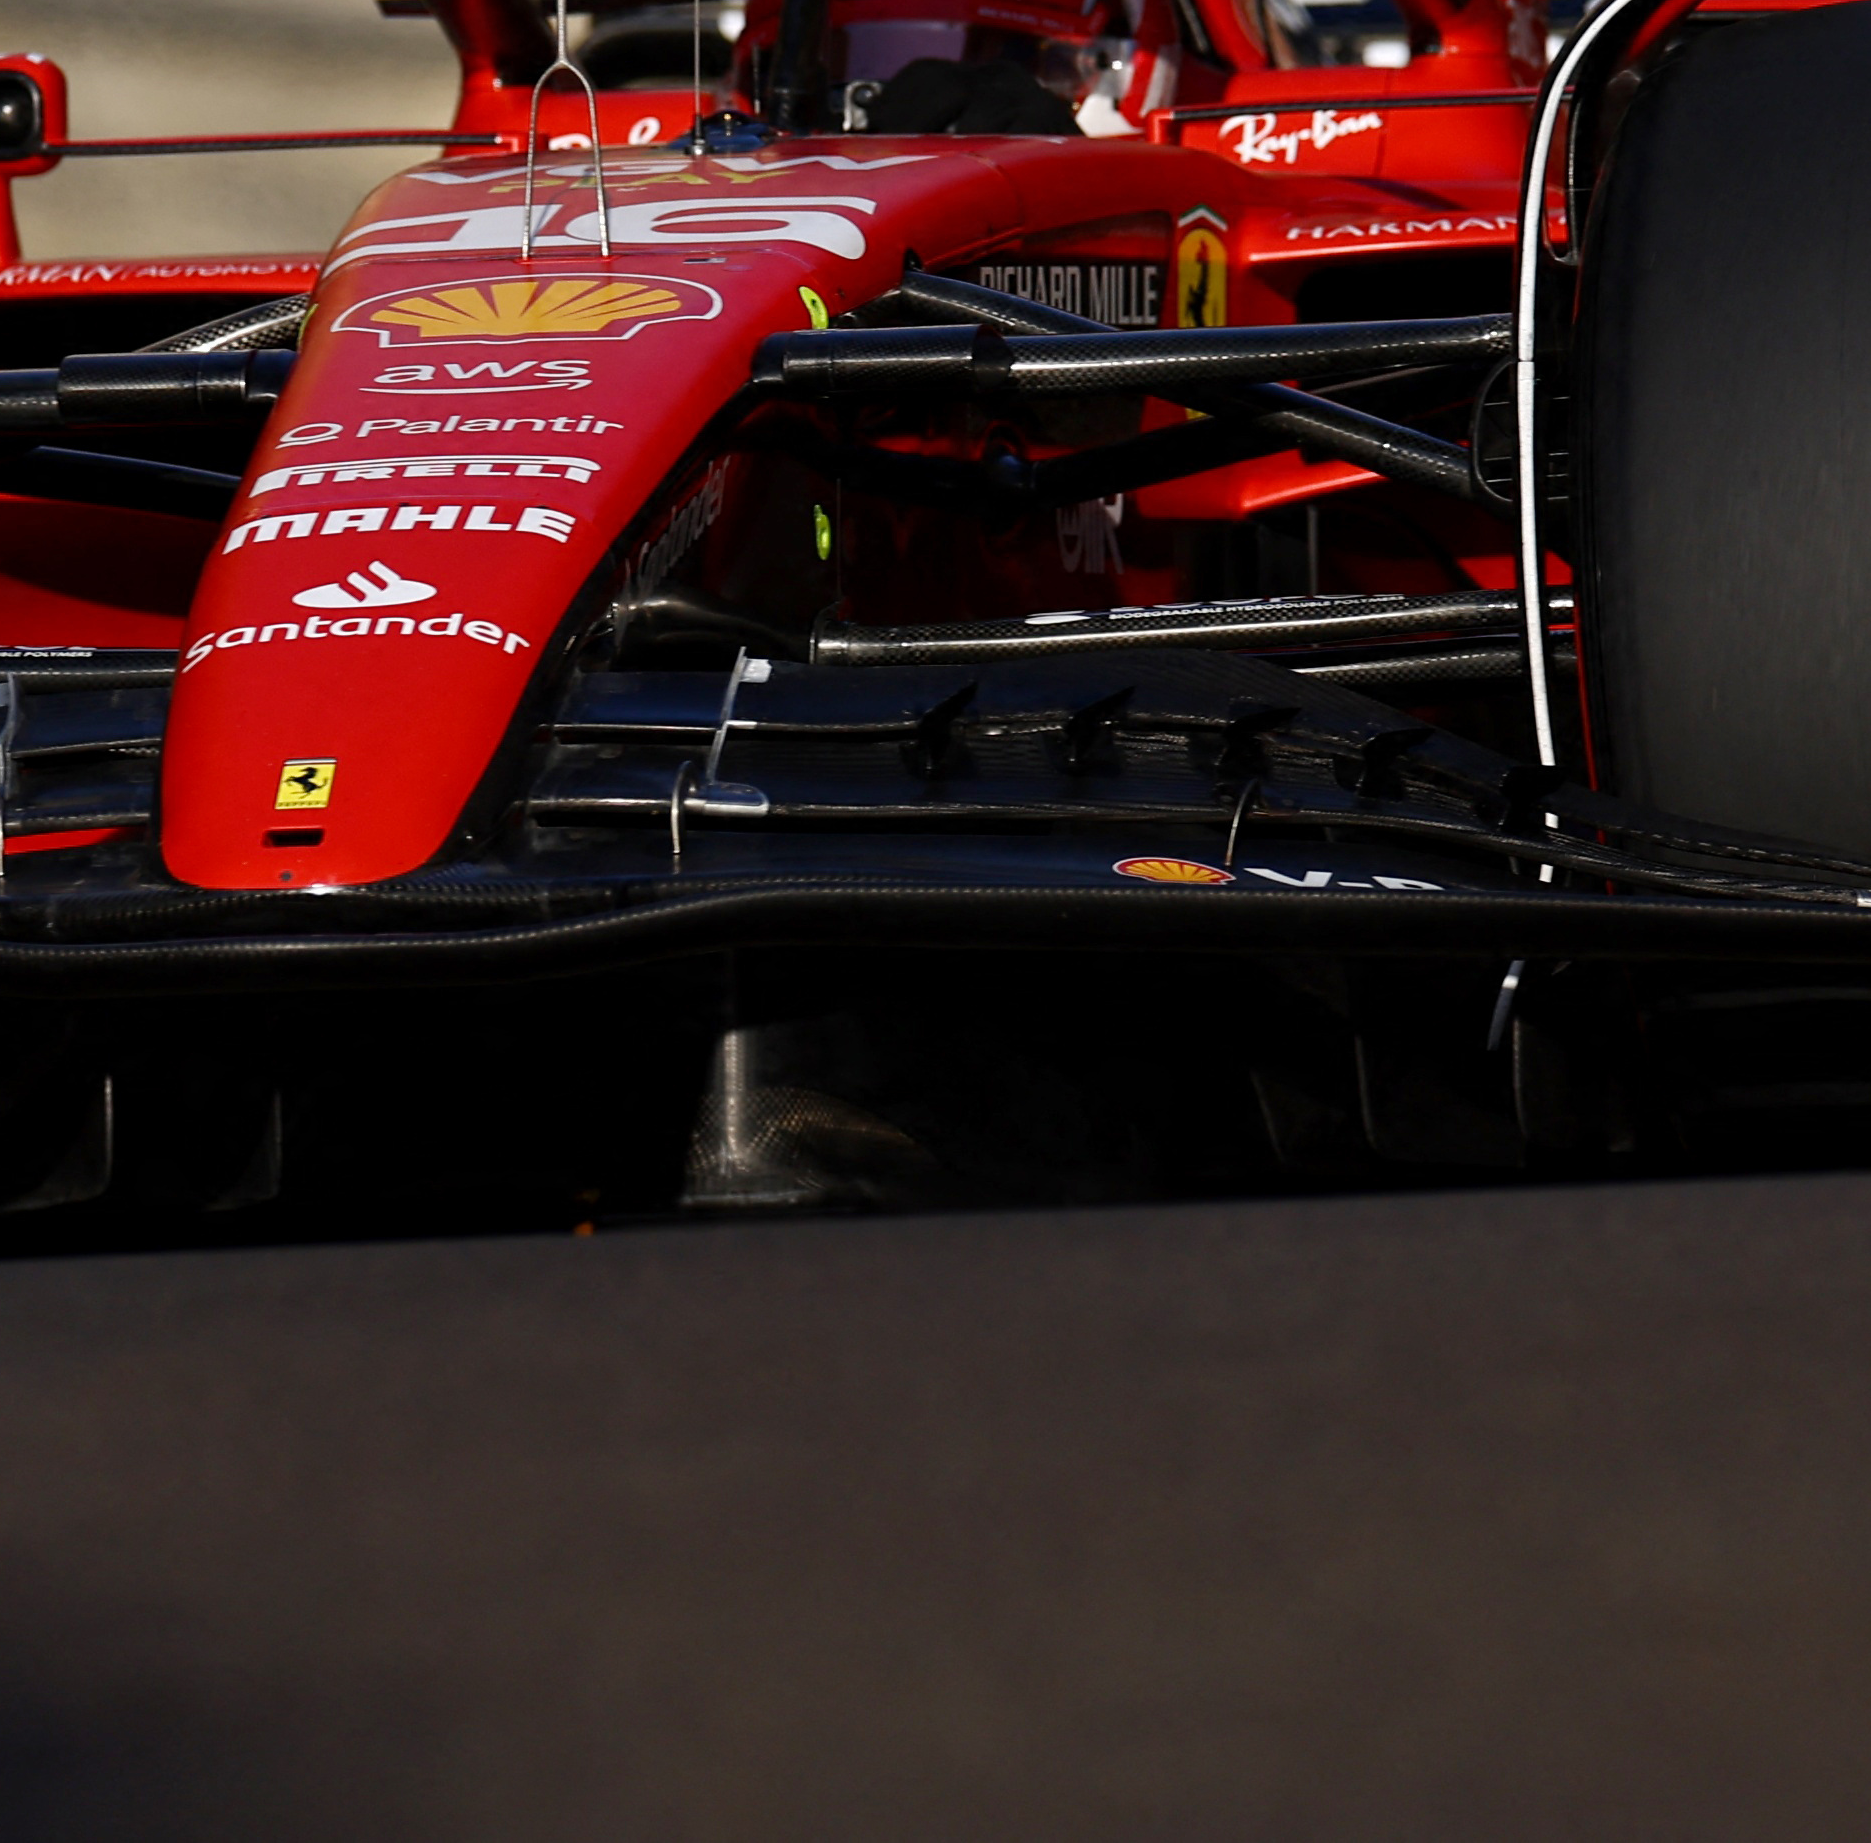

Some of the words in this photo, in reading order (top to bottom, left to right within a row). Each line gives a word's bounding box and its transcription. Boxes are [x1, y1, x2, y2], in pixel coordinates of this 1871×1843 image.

[1219, 110, 1384, 164] Ray-Ban
[405, 154, 939, 186] VGW
[488, 170, 796, 194] PLAY
[320, 196, 878, 280] 16
[1088, 266, 1158, 325] MILLE
[374, 359, 592, 384] aws
[356, 415, 625, 438] Palantir
[248, 455, 602, 499] PIRELLI
[222, 505, 577, 555] MAHLE
[1108, 606, 1225, 621] BIODEGRADABLE
[1334, 594, 1406, 606] POLYMERS
[182, 613, 531, 673] Santander
